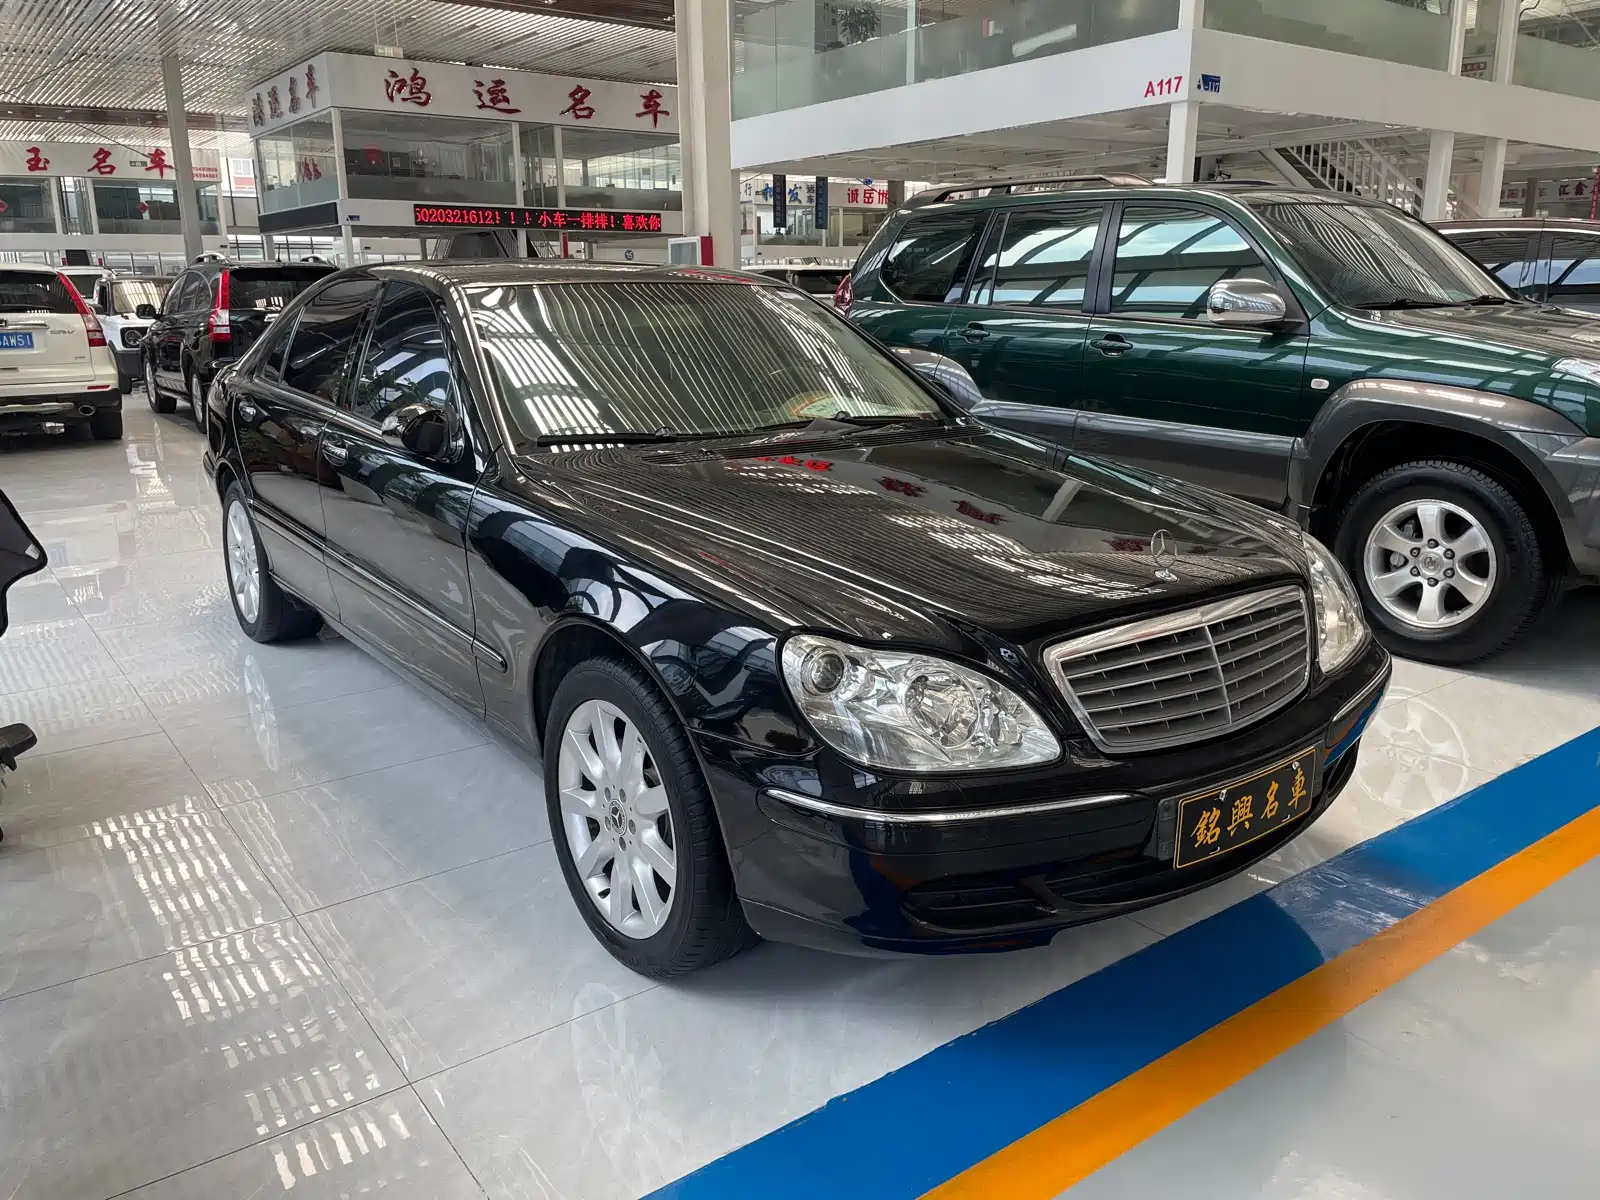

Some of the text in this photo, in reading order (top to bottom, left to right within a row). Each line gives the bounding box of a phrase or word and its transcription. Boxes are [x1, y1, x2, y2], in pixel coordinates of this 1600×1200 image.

[384, 67, 670, 128] 鸿运名车
[1144, 76, 1183, 98] A117
[26, 146, 175, 179] 玉名车
[0, 333, 32, 347] AW51
[1190, 766, 1307, 848] 銘興名車
